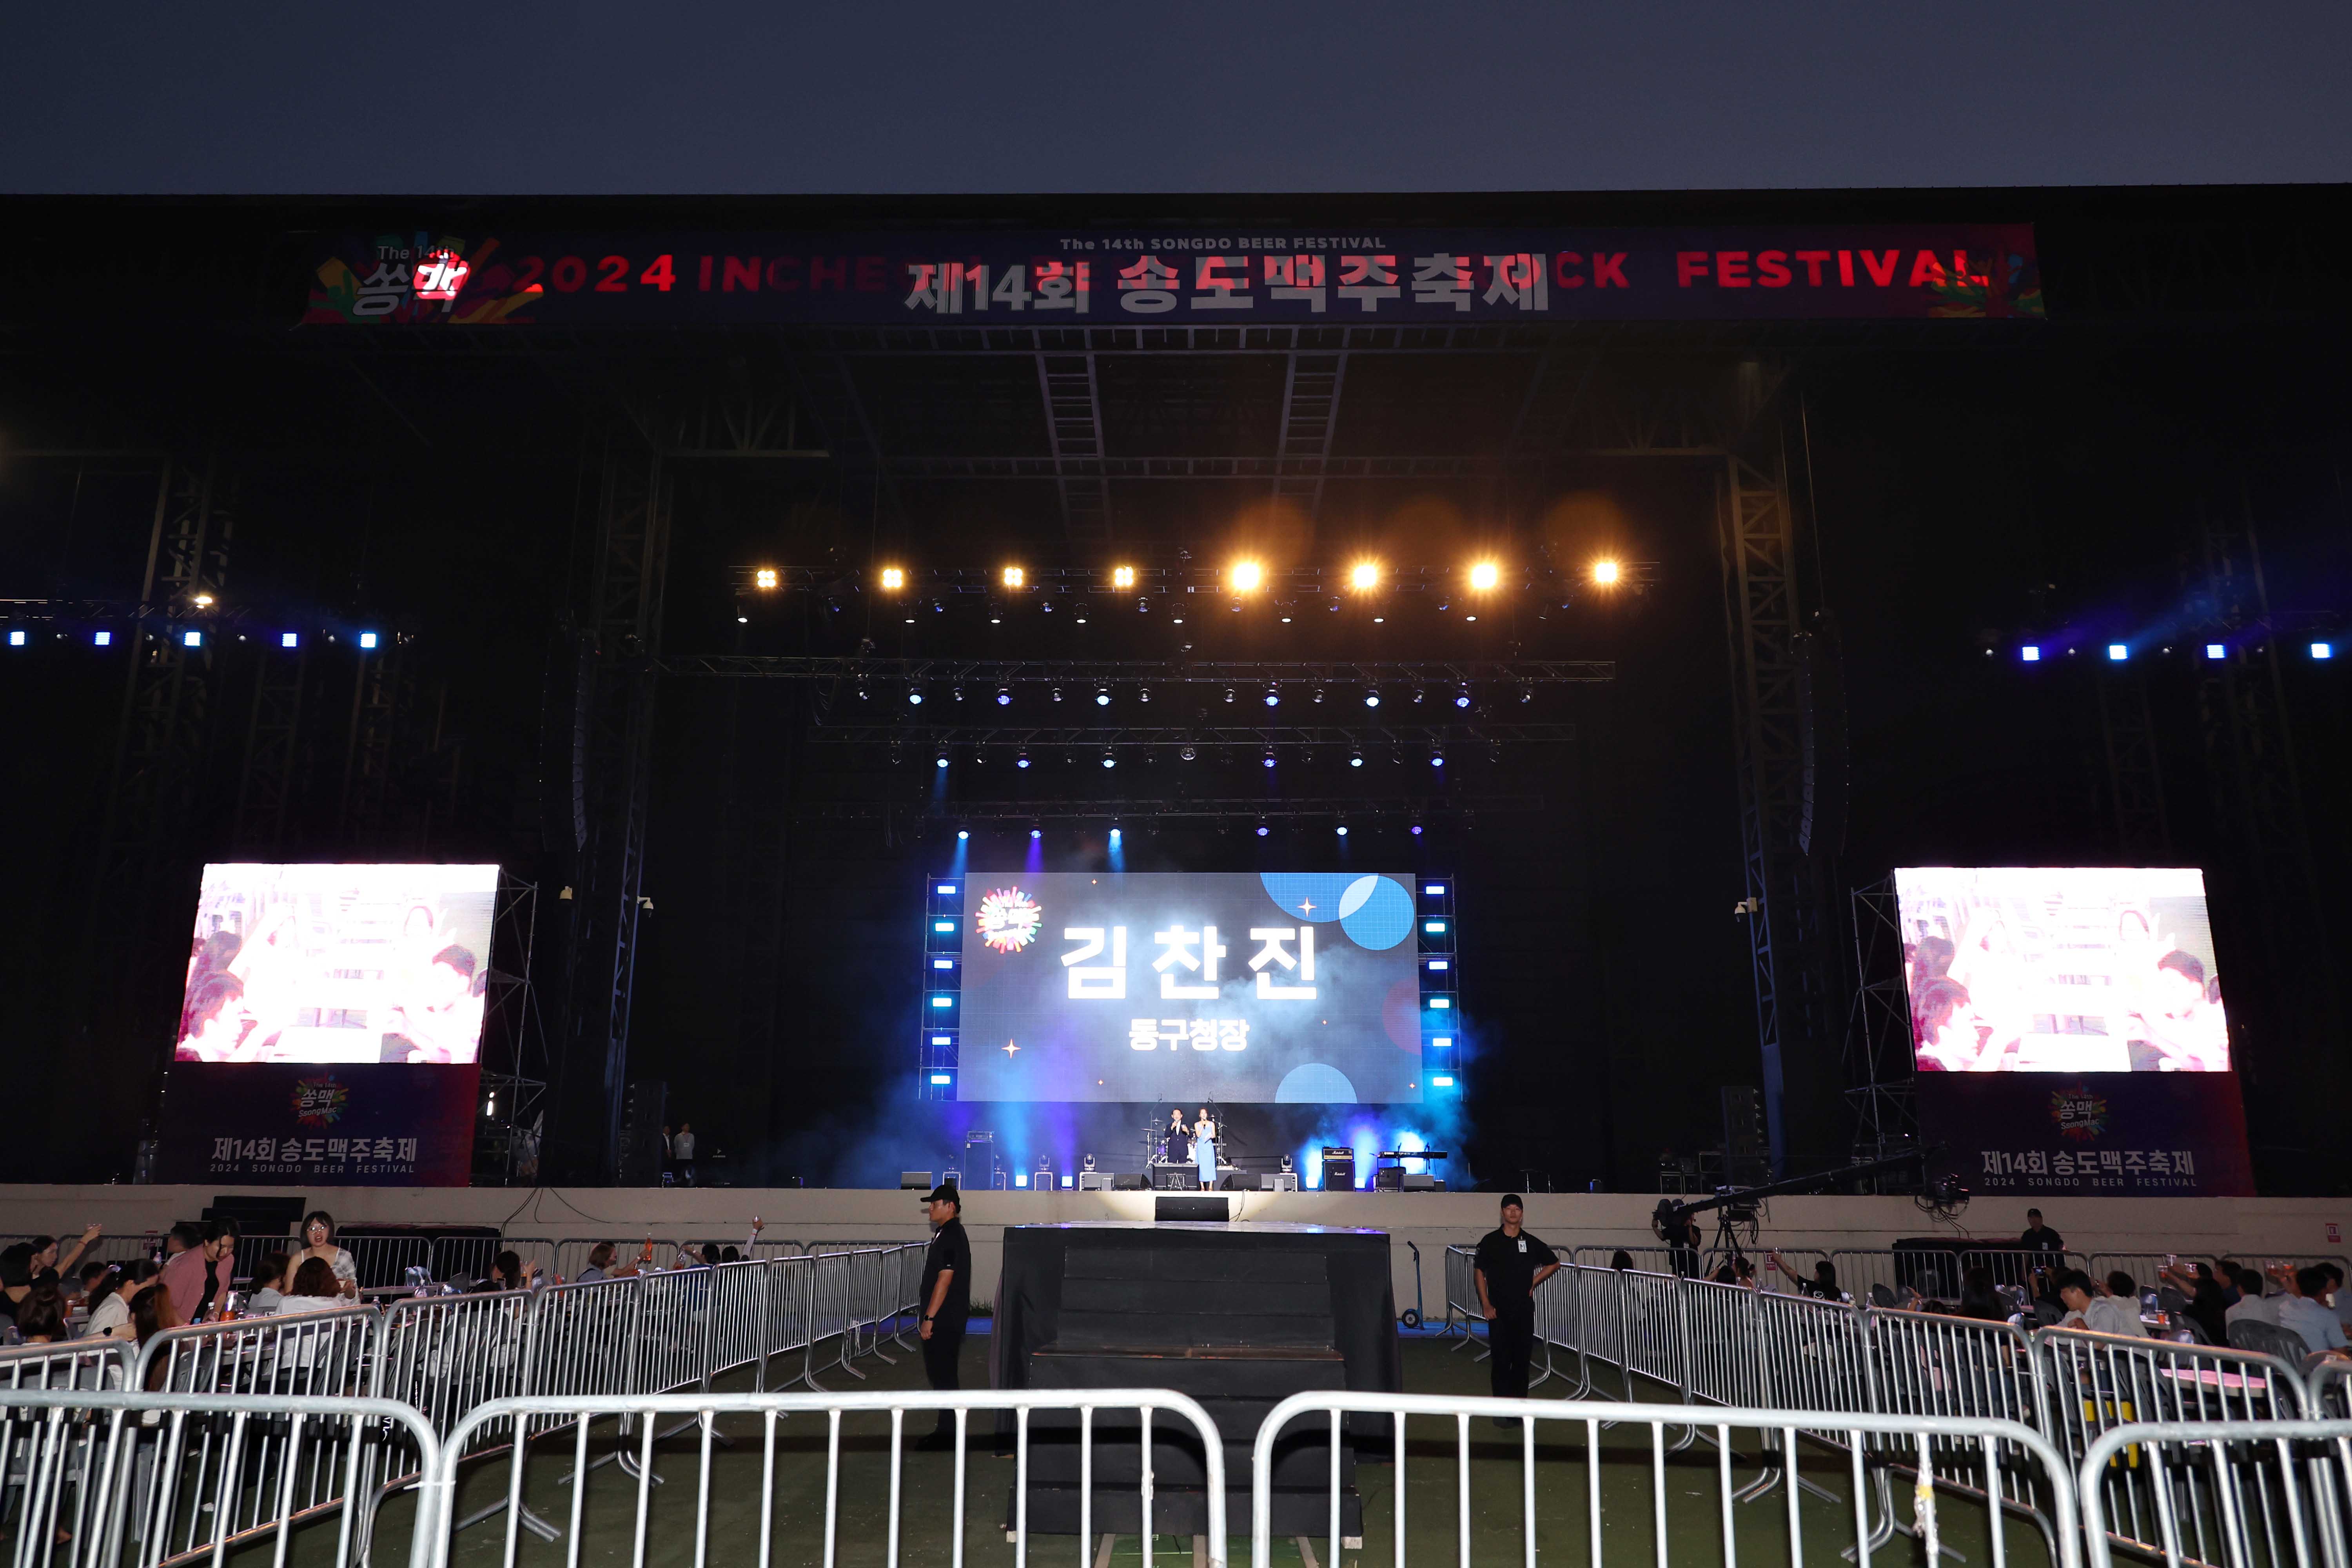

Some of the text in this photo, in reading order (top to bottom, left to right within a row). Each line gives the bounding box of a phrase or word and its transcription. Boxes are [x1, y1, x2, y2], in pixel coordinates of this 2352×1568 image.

[377, 245, 410, 260] The
[1060, 236, 1386, 250] The 14th SONGDO BEER FESTIVAL
[512, 254, 678, 296] 2024
[1676, 249, 1989, 288] FESTIVAL
[904, 252, 1548, 314] 제14회 송도맥주축제
[1128, 1018, 1250, 1051] 동구청장
[300, 1089, 335, 1107] 쏭맥
[298, 1107, 337, 1118] SsongMac
[2059, 1100, 2092, 1120] 쏭맥
[211, 1136, 417, 1163] 제14회 송도맥주축제
[210, 1164, 414, 1173] 2024 SONGDO BEER FESTIVAL
[1981, 1149, 2195, 1176] 제14회 송도맥주축제
[1984, 1178, 2197, 1187] 2024 SONGDO BEER FESTIVAL
